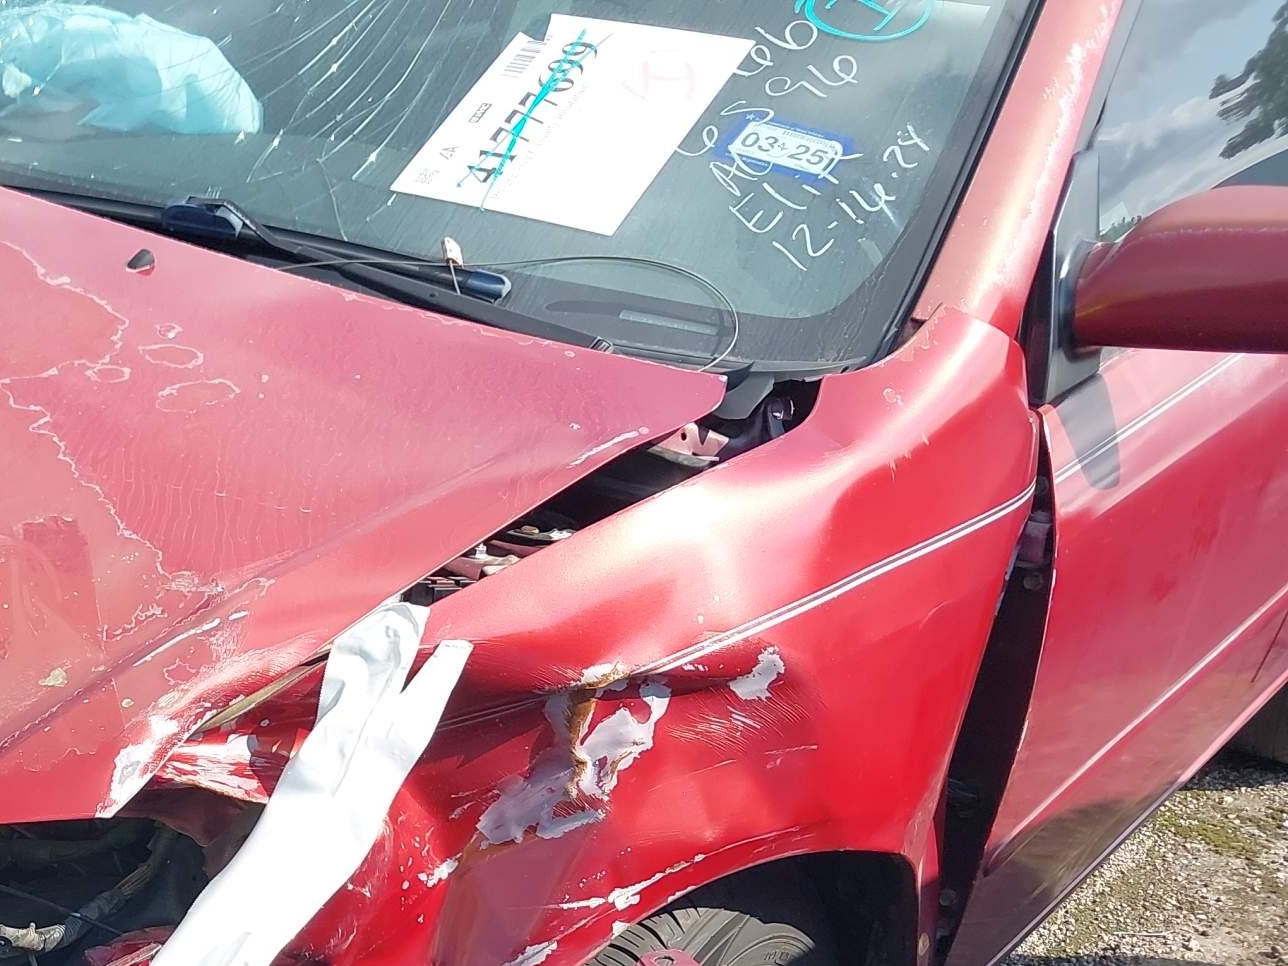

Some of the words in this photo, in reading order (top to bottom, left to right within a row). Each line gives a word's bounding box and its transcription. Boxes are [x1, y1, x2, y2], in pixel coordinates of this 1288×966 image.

[466, 41, 599, 185] 41777699
[740, 131, 779, 153] 03
[787, 144, 829, 166] 25
